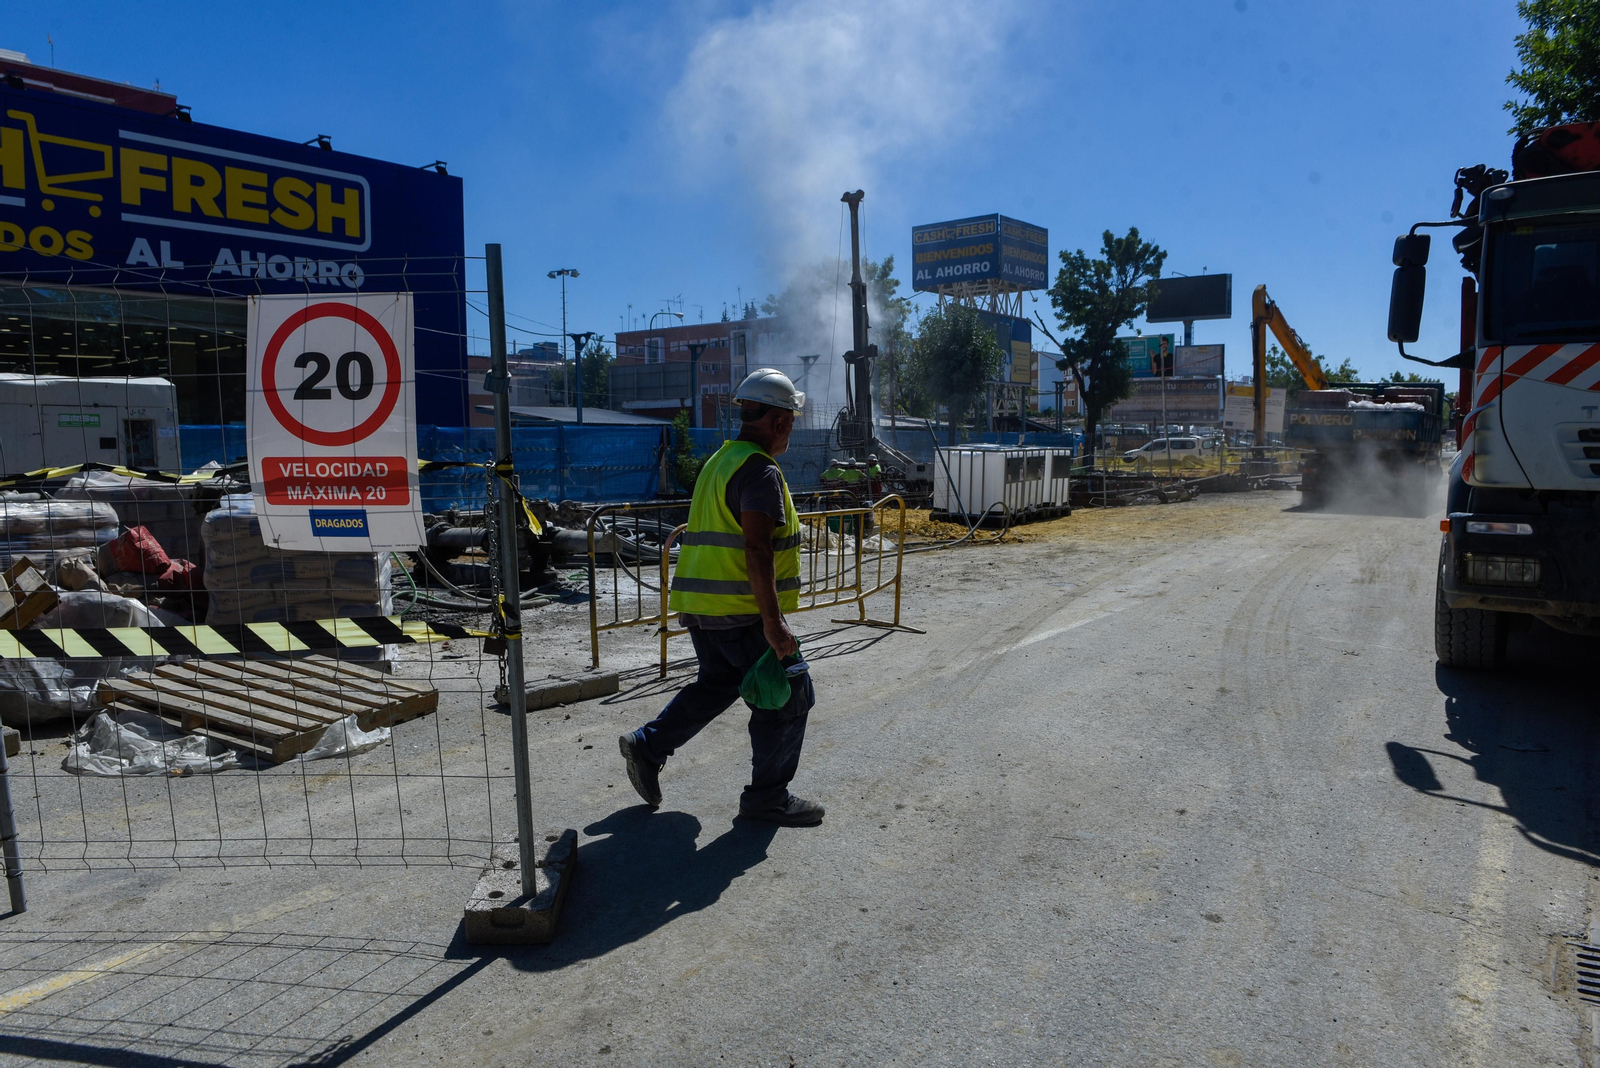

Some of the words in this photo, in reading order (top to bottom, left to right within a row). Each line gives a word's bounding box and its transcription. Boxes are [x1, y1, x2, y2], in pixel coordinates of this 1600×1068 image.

[120, 147, 361, 238] FRESH
[915, 229, 945, 243] CASH
[956, 223, 994, 237] FRESH
[1001, 224, 1021, 237] CASH
[1025, 230, 1047, 244] FRESH
[126, 237, 184, 269] AL
[212, 247, 365, 289] AHORRO
[915, 243, 994, 263] BIENVENIDOS
[1003, 245, 1047, 265] BIENVENIDOS
[916, 270, 932, 281] AL
[935, 261, 991, 278] AHORRO
[1003, 262, 1013, 274] AL
[1014, 266, 1045, 282] AHORRO
[293, 351, 374, 400] 20
[1290, 413, 1353, 426] POLVERO
[279, 463, 388, 478] VELOCIDAD
[287, 482, 361, 500] MÁXIMA
[366, 485, 386, 500] 20
[315, 518, 364, 528] DRAGADOS
